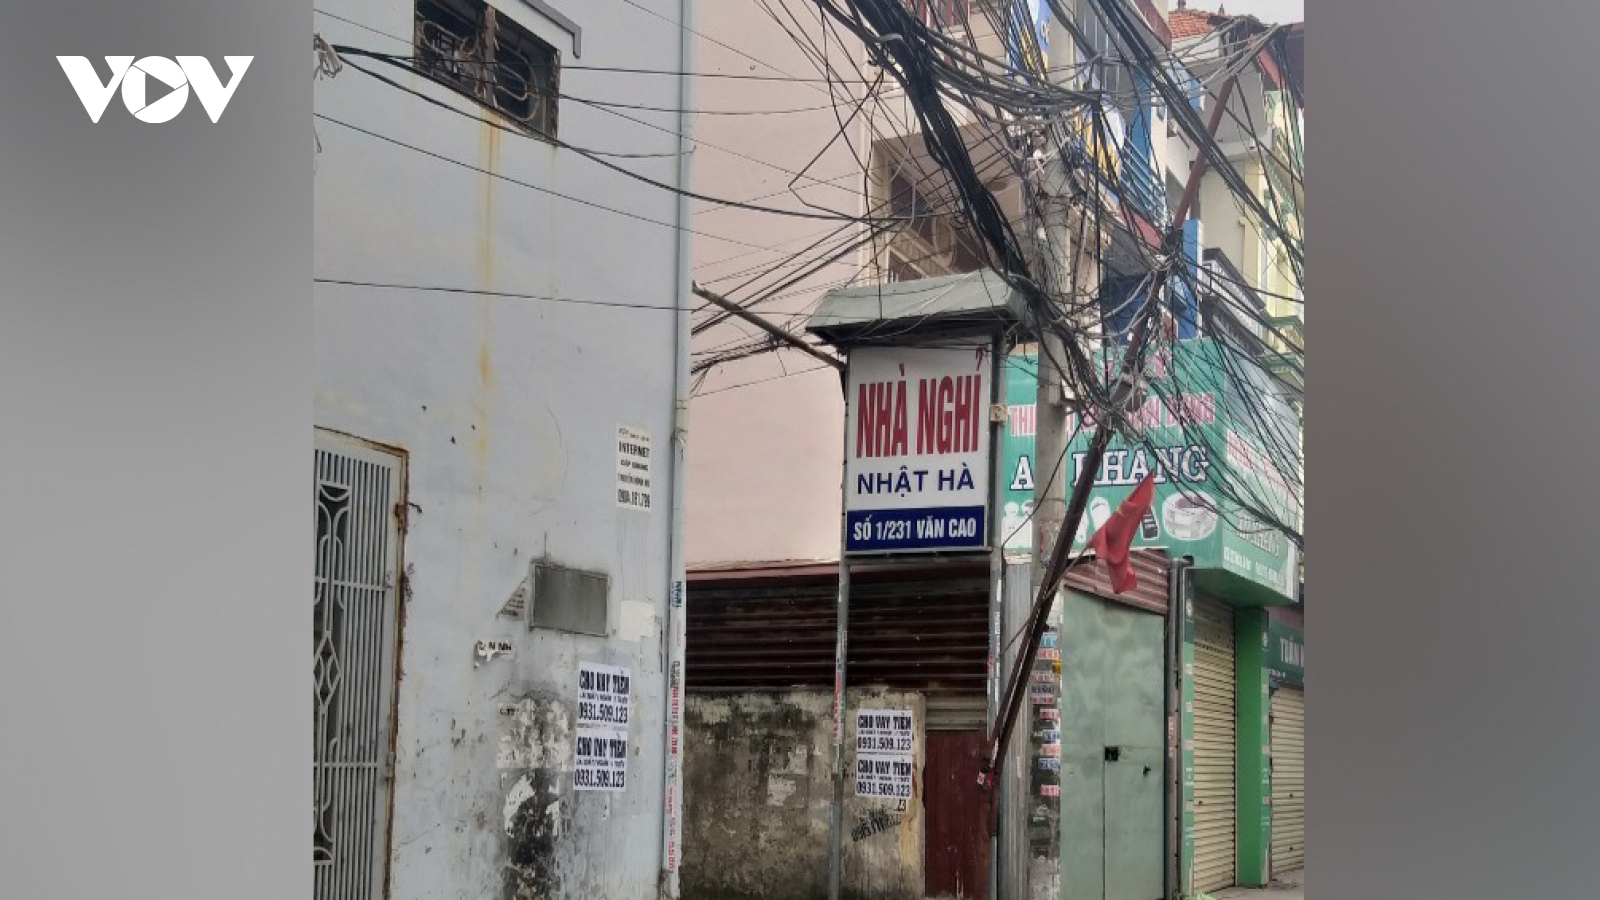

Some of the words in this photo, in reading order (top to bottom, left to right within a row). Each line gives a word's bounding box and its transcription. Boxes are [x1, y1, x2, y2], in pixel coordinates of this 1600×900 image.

[856, 362, 908, 459] NHÀ
[916, 347, 982, 455] NGHỈ
[618, 440, 650, 458] INTERNET
[857, 465, 929, 498] NHẬT
[937, 462, 975, 492] HÀ
[853, 513, 873, 541] SỐ
[875, 520, 912, 541] 1/231
[916, 515, 945, 540] VĂN
[948, 517, 977, 539] CAO
[579, 669, 595, 691] CHO
[596, 671, 611, 692] VAY
[578, 702, 628, 724] 0931.509.123
[858, 714, 874, 729] CHO
[875, 715, 891, 729] VAY
[577, 735, 592, 756] CHO
[593, 738, 609, 758] VAY
[857, 736, 912, 751] 0931.509.123
[858, 759, 873, 774] CHO
[875, 760, 891, 775] VAY
[574, 769, 625, 788] 0931.509.123
[856, 781, 911, 797] 0931.509.123
